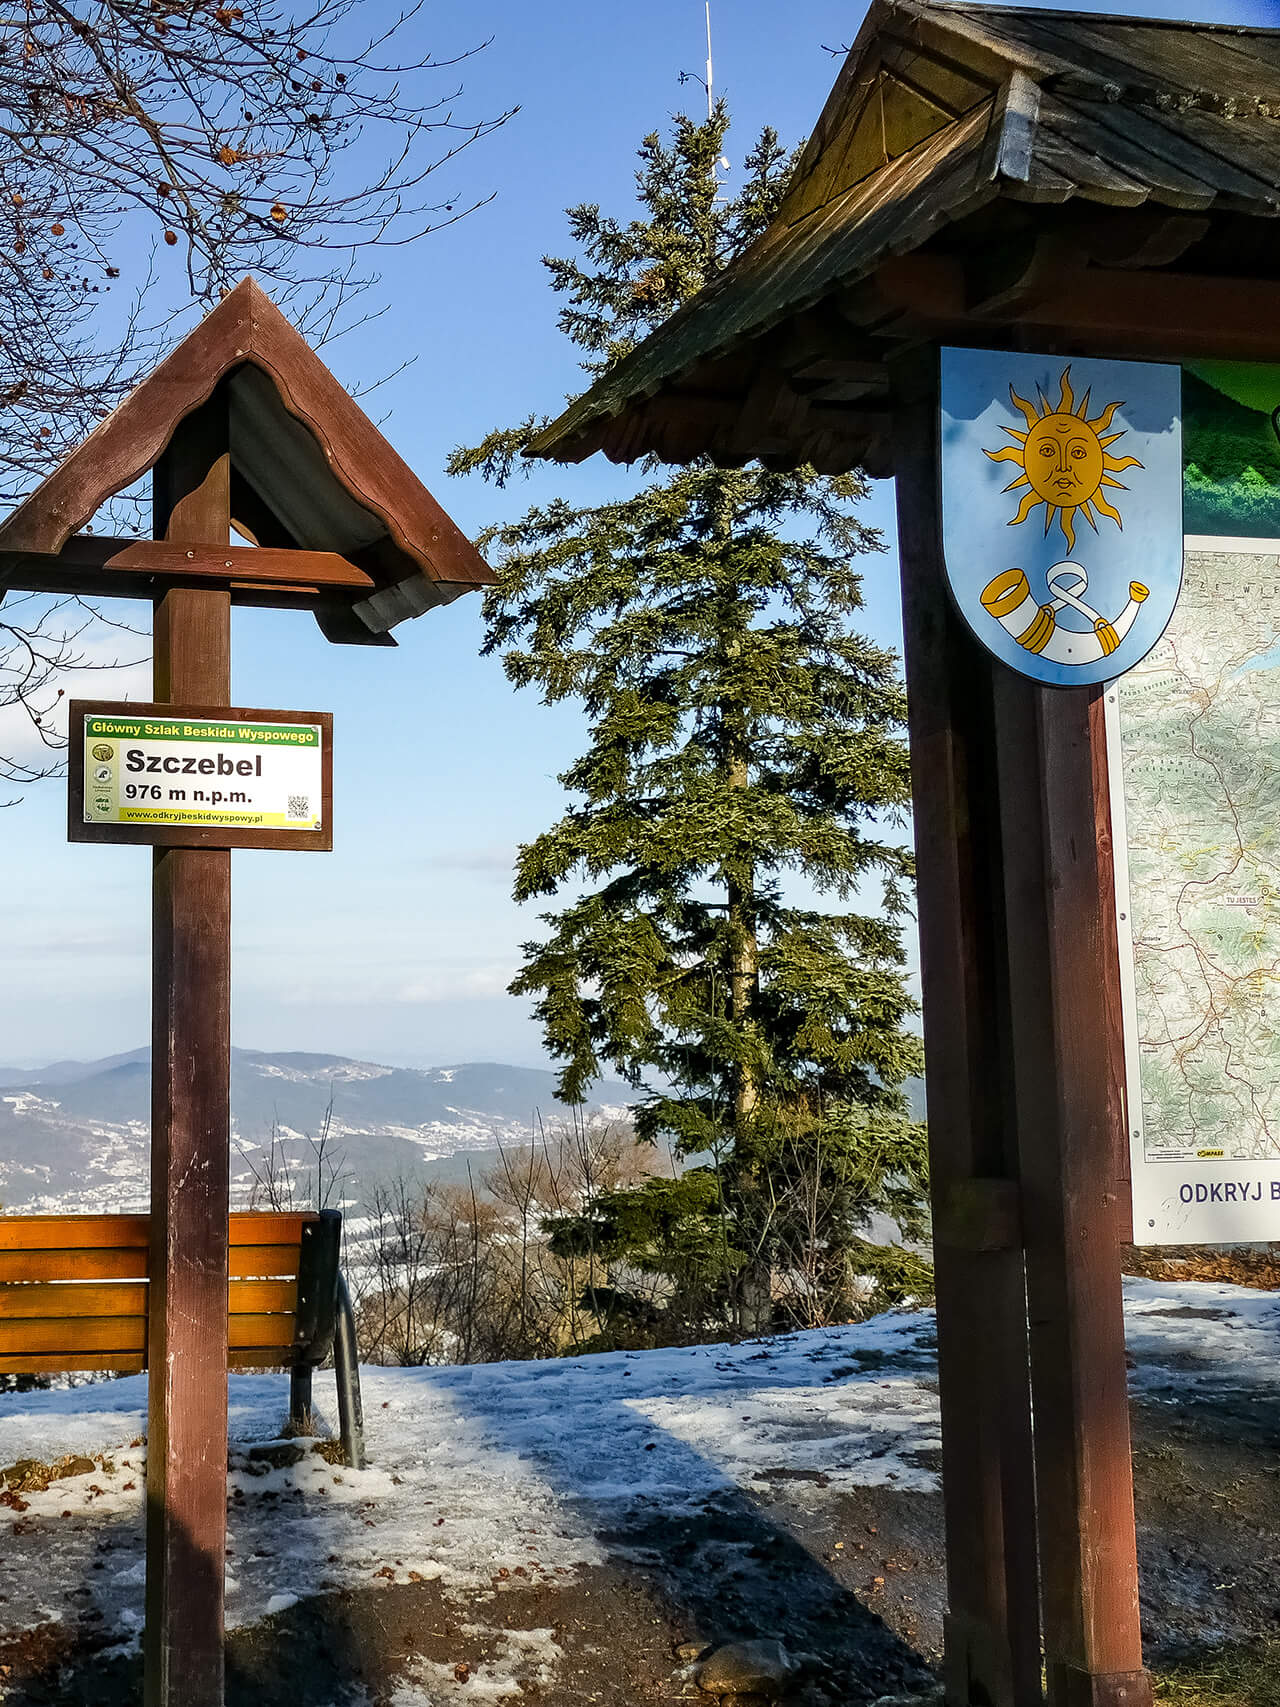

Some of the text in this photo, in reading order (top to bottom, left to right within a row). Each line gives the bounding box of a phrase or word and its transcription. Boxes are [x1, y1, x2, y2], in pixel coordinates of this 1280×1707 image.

[92, 721, 314, 743] Główny Szlak Beskidu Wyspowego
[125, 749, 262, 777] Szczebel
[125, 784, 162, 800] 976
[168, 789, 186, 801] m
[193, 789, 252, 805] n.p.m.
[126, 811, 263, 823] www.odkryjbeskidwyspowy.pl
[1179, 1181, 1262, 1204] ODKRYJ
